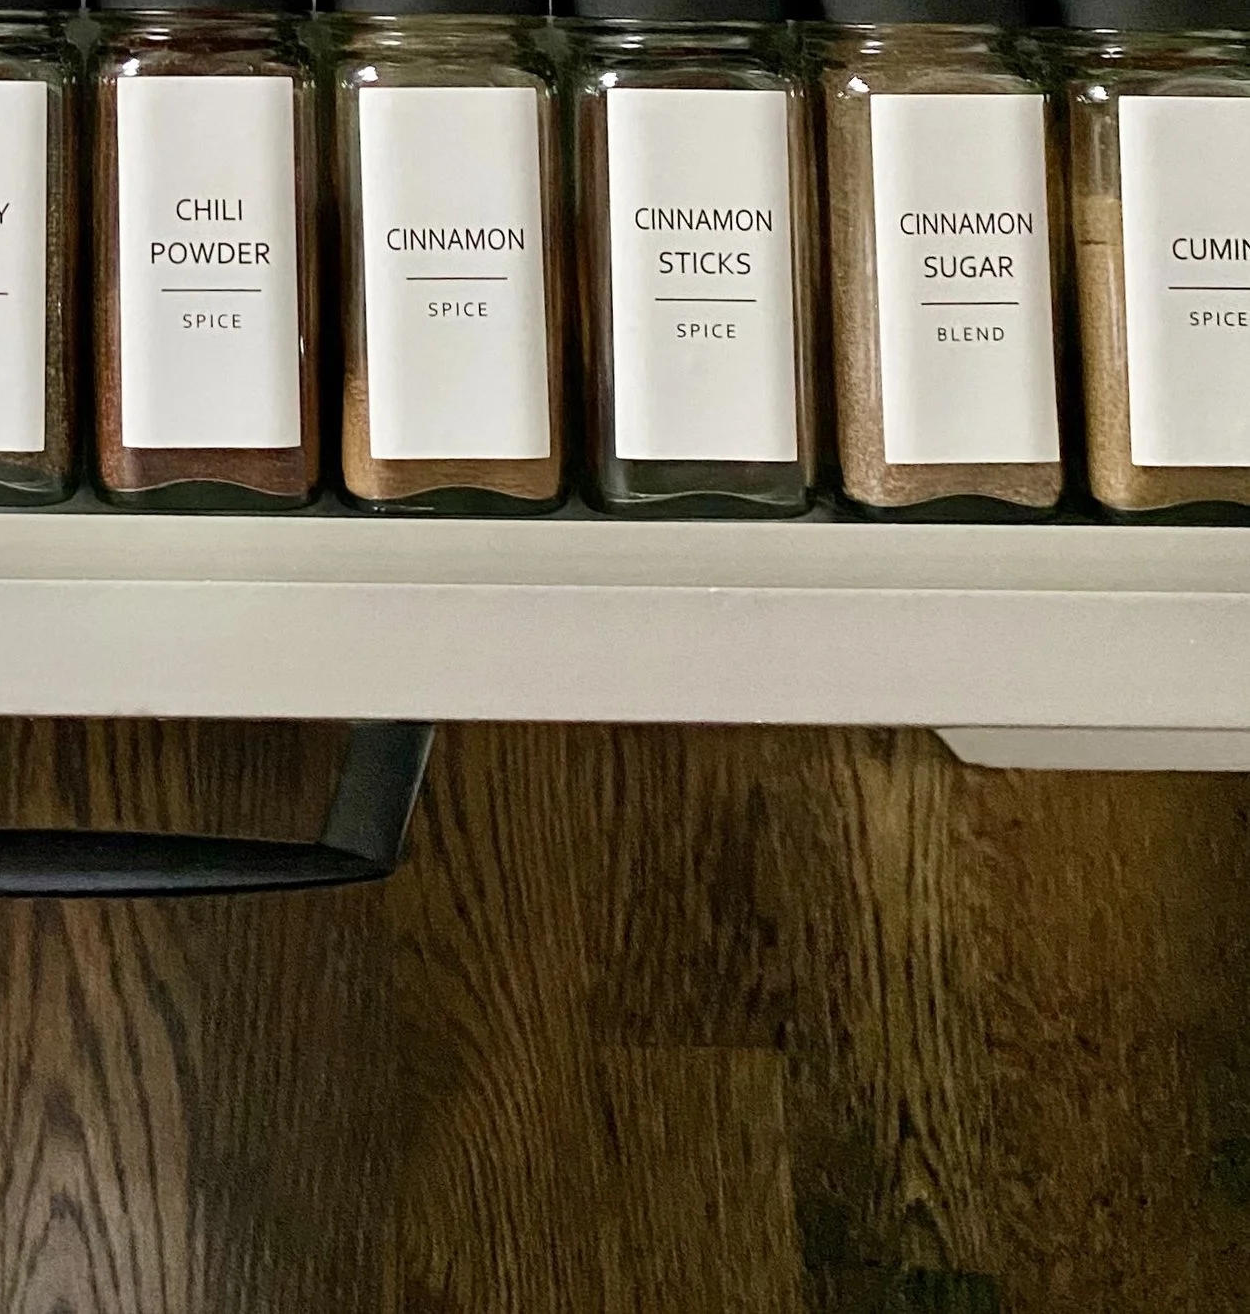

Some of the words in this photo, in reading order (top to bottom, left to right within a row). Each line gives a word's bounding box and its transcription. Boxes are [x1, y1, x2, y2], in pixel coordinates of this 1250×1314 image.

[175, 197, 243, 222] CHILI
[634, 206, 773, 233] CINNAMON
[899, 211, 1034, 236] CINNAMON
[386, 227, 525, 252] CINNAMON
[150, 241, 271, 266] POWDER
[658, 250, 752, 276] STICKS
[923, 254, 1015, 279] SUGAR
[182, 313, 242, 330] SPICE
[428, 301, 489, 318] SPICE
[1189, 310, 1249, 328] SPICE
[676, 322, 737, 340] SPICE
[936, 326, 1005, 343] BLEND
